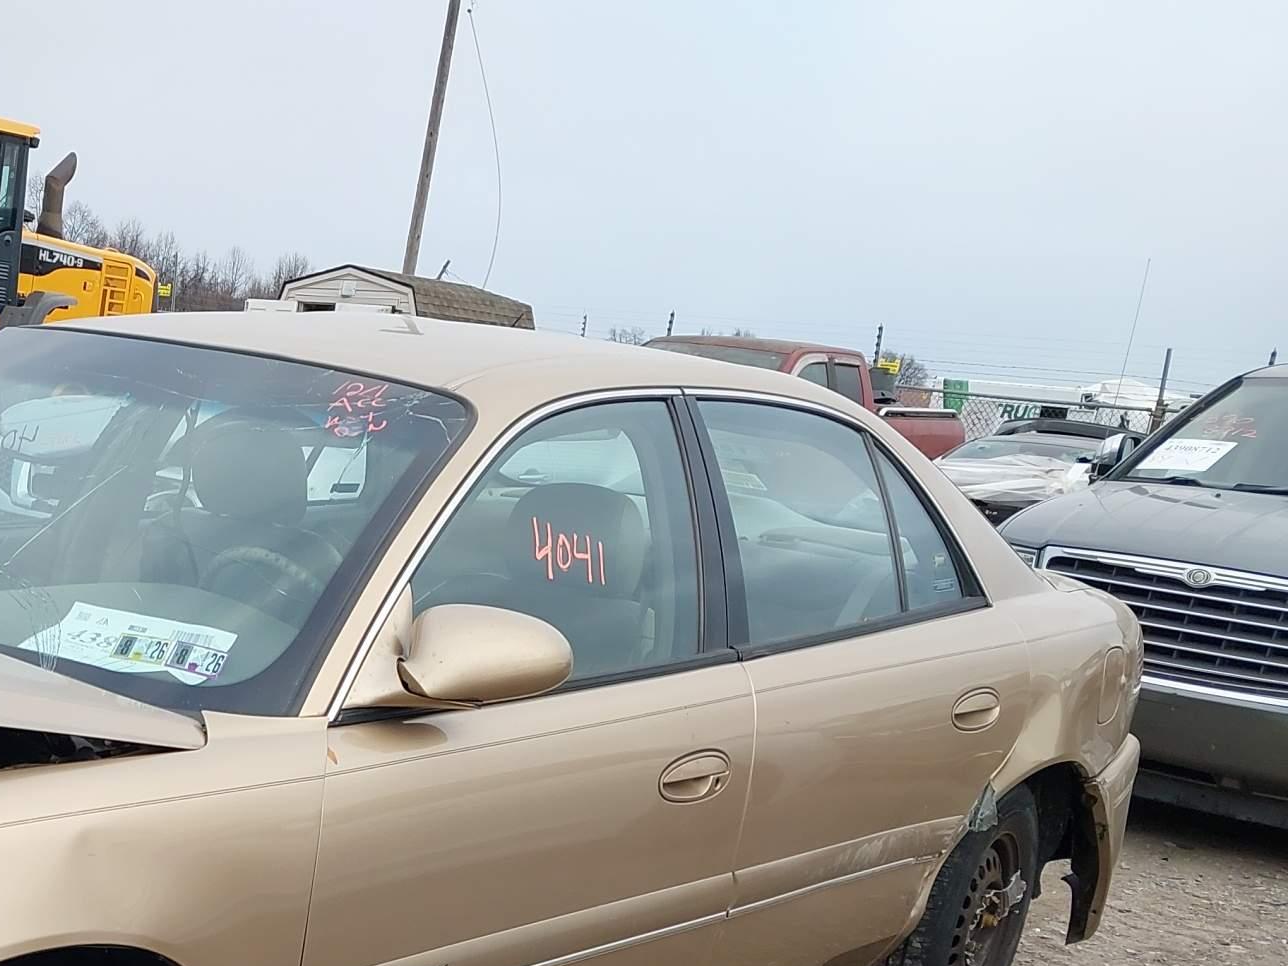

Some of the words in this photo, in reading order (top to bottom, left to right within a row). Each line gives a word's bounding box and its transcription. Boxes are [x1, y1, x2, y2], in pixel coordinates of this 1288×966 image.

[38, 248, 83, 268] HL740-9
[532, 516, 606, 586] 4041
[149, 640, 169, 661] 26
[205, 652, 226, 674] 26
